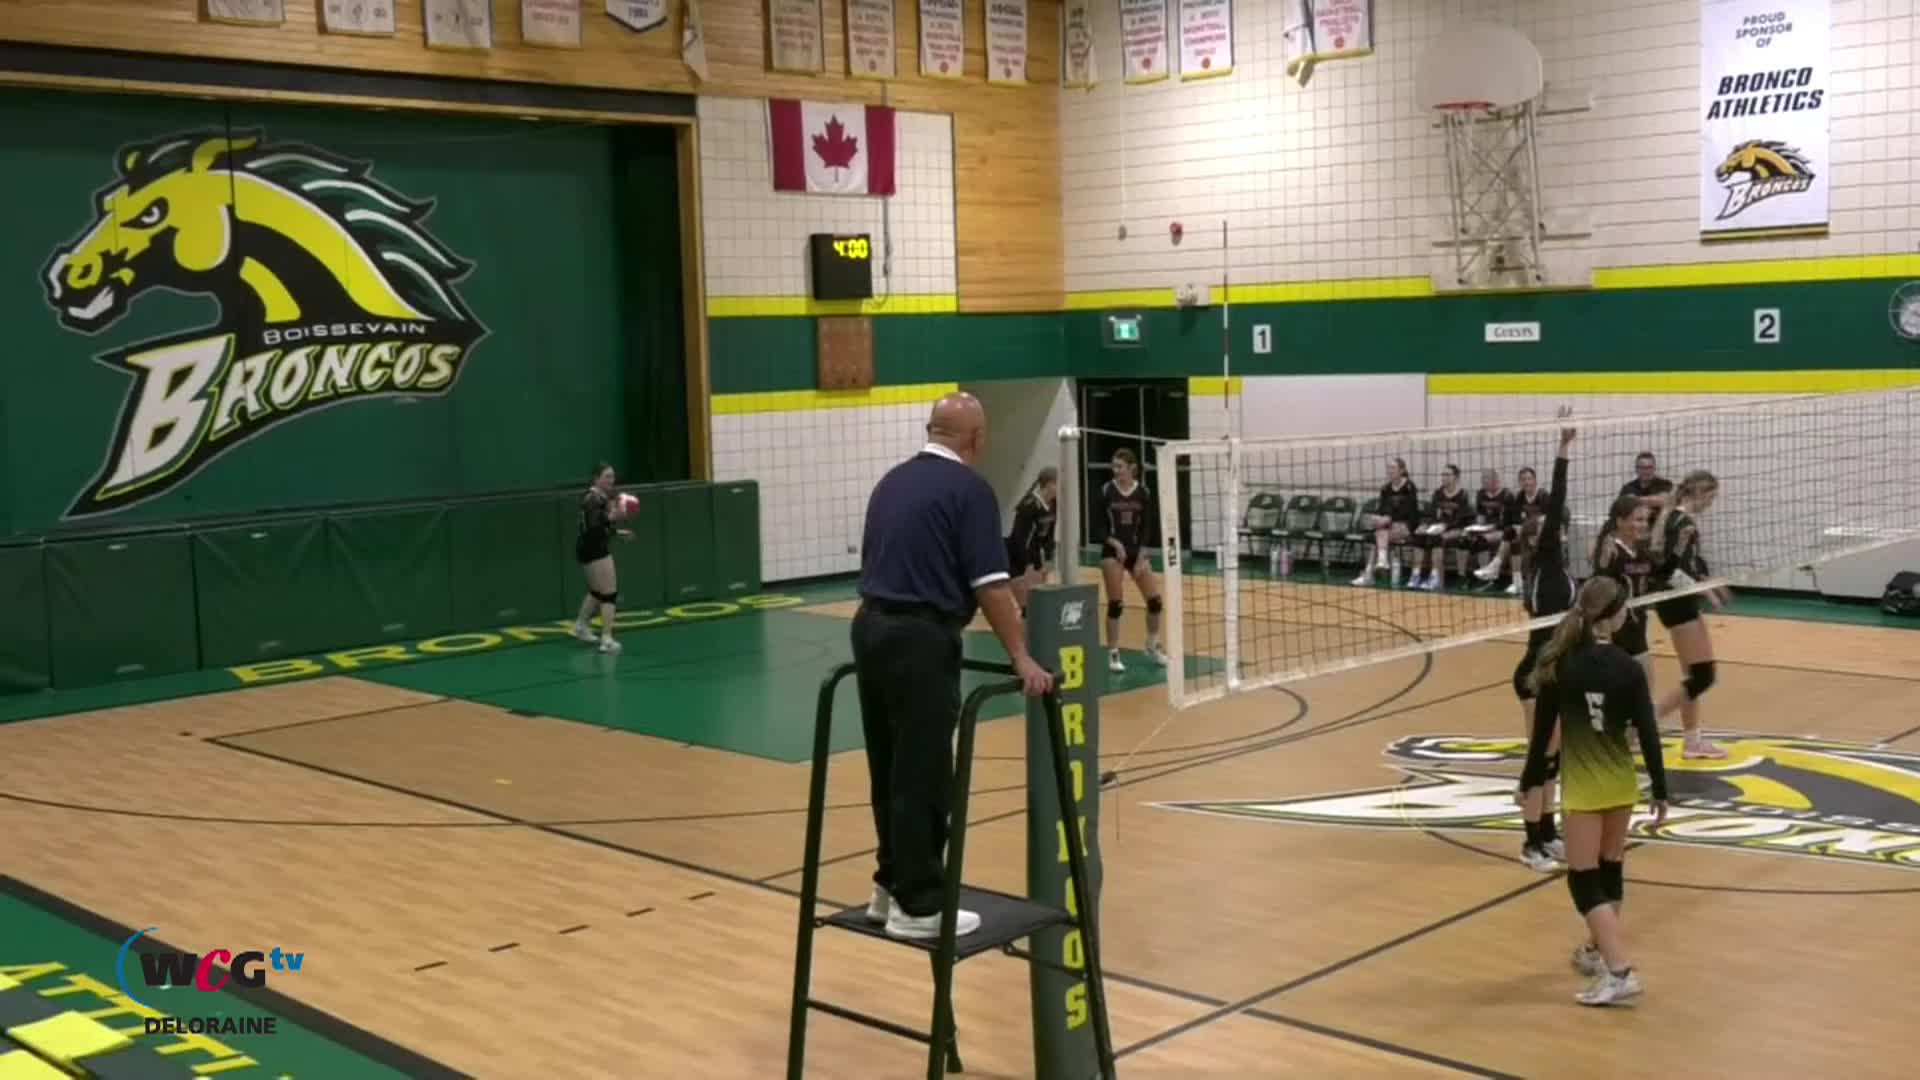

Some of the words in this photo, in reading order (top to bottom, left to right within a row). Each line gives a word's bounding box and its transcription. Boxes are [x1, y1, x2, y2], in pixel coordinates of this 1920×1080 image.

[1736, 22, 1792, 39] SPONSOR
[1743, 12, 1785, 26] PROUD
[1756, 37, 1772, 48] OF
[1718, 67, 1813, 96] BRONCO
[1707, 89, 1824, 120] ATHLETICS
[1715, 175, 1809, 220] BRONCOS
[262, 323, 426, 345] BOISSEVAIN
[1257, 329, 1267, 350] 1
[1758, 313, 1777, 339] 2
[96, 333, 462, 501] BRONCOS
[226, 591, 804, 683] BRONCOS
[1584, 691, 1605, 732] 5
